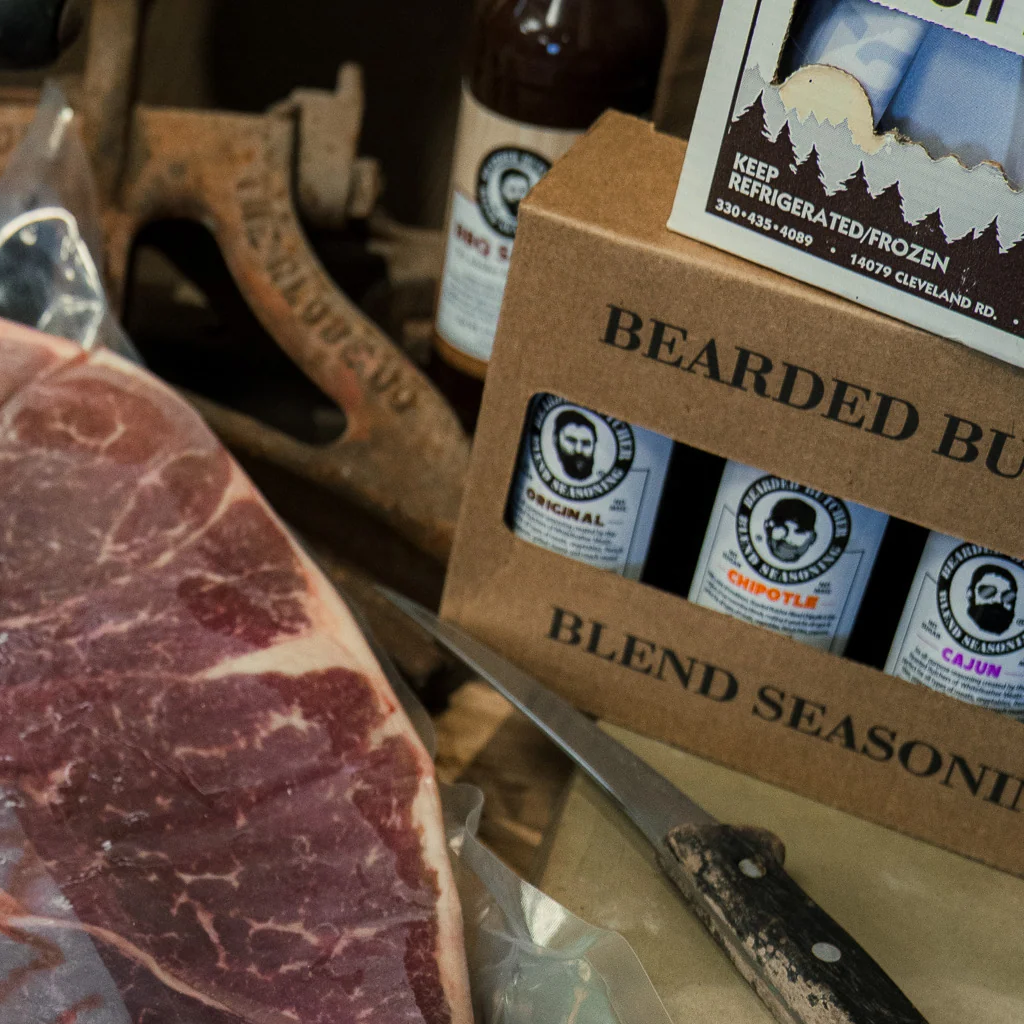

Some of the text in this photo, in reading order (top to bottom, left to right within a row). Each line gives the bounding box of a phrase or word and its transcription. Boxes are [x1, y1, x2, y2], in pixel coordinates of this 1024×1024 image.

[733, 152, 780, 184] KEEP
[728, 172, 950, 275] REFRIGERATED/FROZEN
[850, 253, 892, 278] 14079
[894, 271, 972, 310] CLEVELAND
[974, 302, 997, 321] RD.
[598, 303, 919, 442] BEARDED
[932, 413, 1024, 479] BU
[527, 487, 605, 528] ORIGINAL
[727, 568, 819, 610] CHIPOTLE
[545, 607, 739, 703] BLEND
[941, 647, 1002, 679] CAJUN
